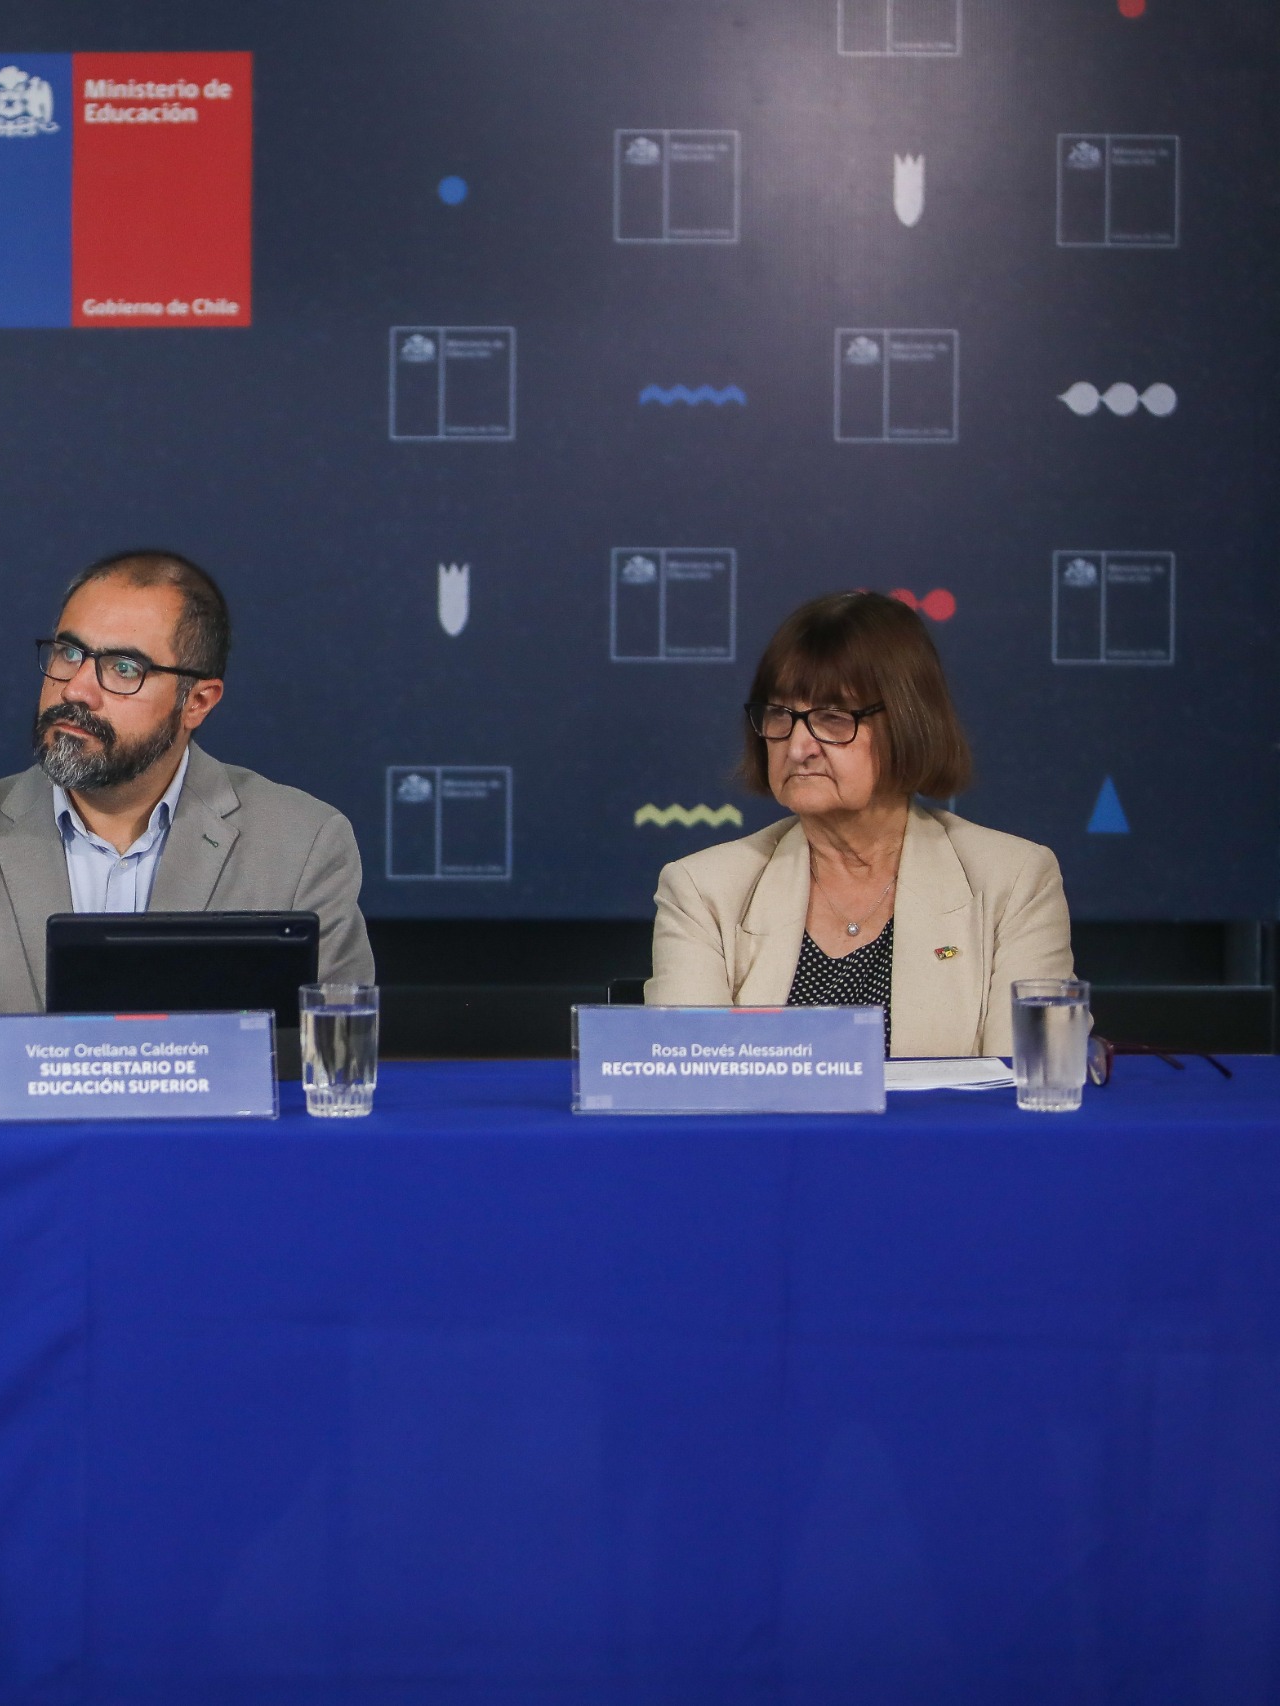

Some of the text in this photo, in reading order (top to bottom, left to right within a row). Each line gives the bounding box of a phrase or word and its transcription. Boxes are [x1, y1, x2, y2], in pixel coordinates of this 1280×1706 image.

[84, 79, 232, 99] Ministerio de
[84, 102, 198, 123] Educación
[82, 298, 240, 316] Gobierno de Chile
[73, 1043, 137, 1058] Orellana
[140, 1041, 209, 1056] Calderón
[651, 1043, 812, 1058] Rosa Devés Alessandri
[40, 1060, 196, 1076] SUBSECRETARIO DE
[602, 1061, 863, 1076] RECTORA UNIVERSIDAD DE CHILE
[27, 1077, 209, 1095] EDUCACIÓN SUPERIOR
